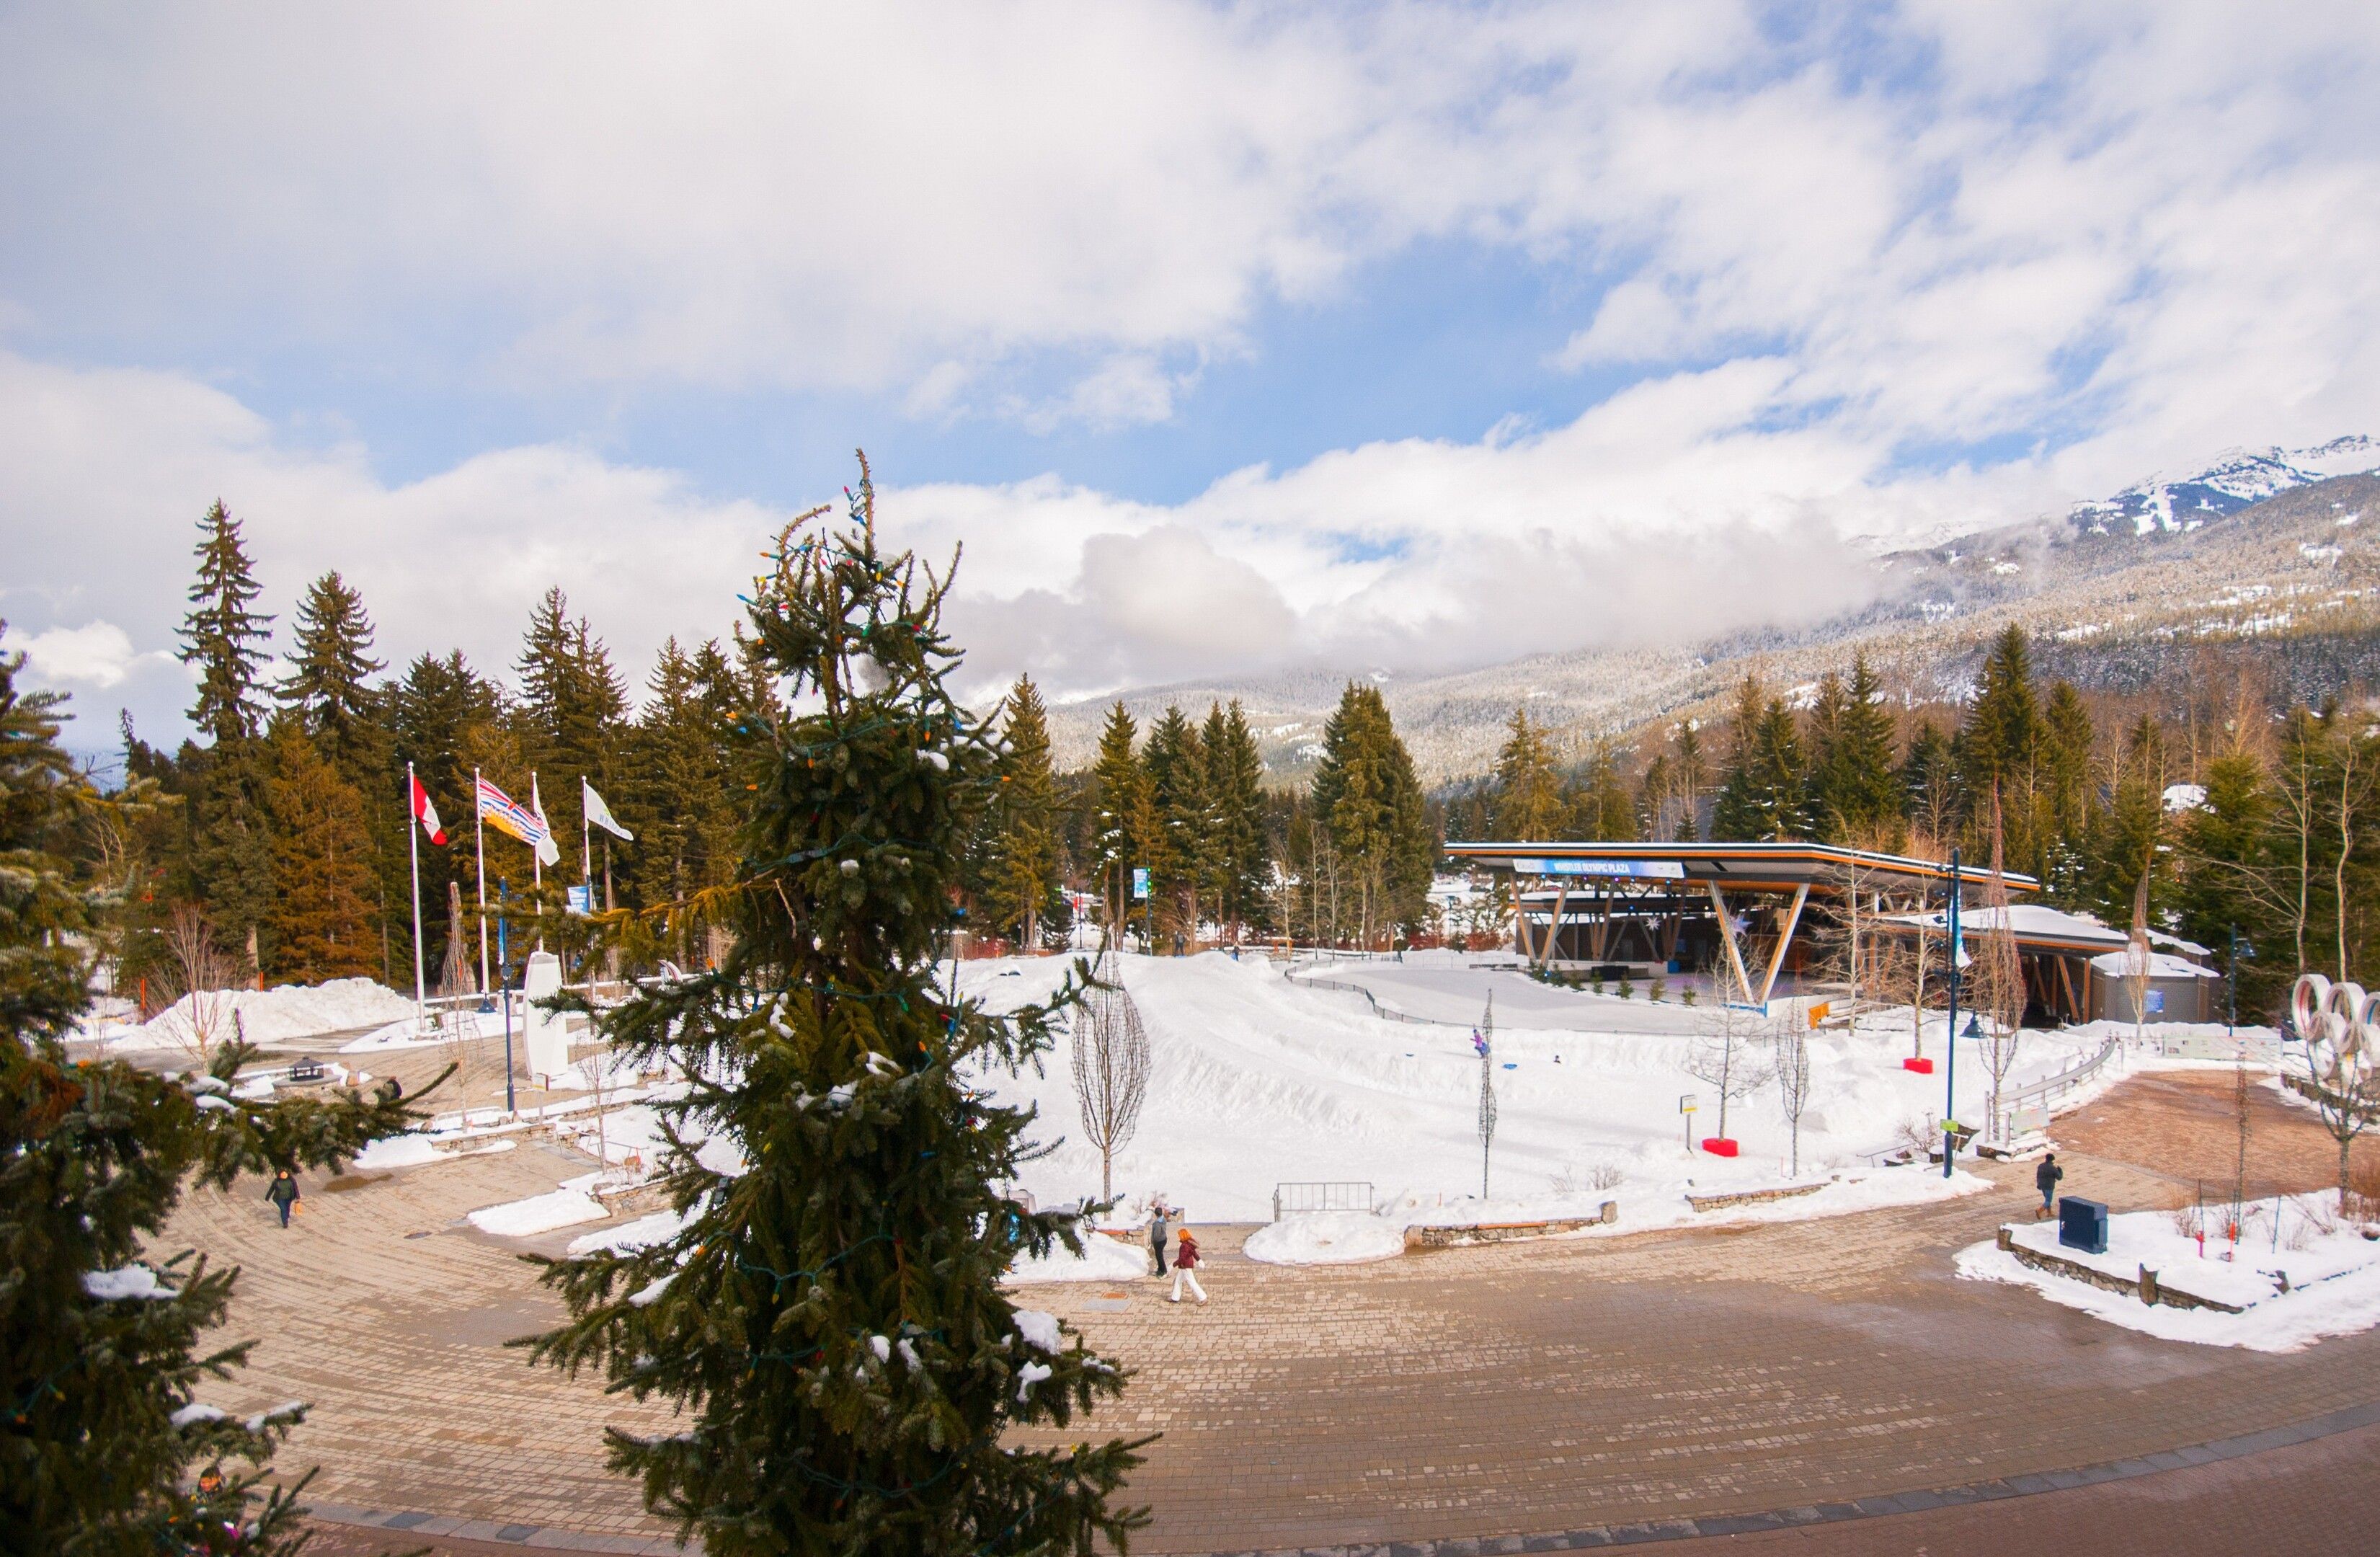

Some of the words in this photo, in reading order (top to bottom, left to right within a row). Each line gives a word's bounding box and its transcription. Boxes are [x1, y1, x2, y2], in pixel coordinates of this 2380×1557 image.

[1554, 862, 1582, 872] WHISTLER
[1582, 863, 1608, 873] OLYMPIC
[1608, 864, 1630, 874] PLAZA
